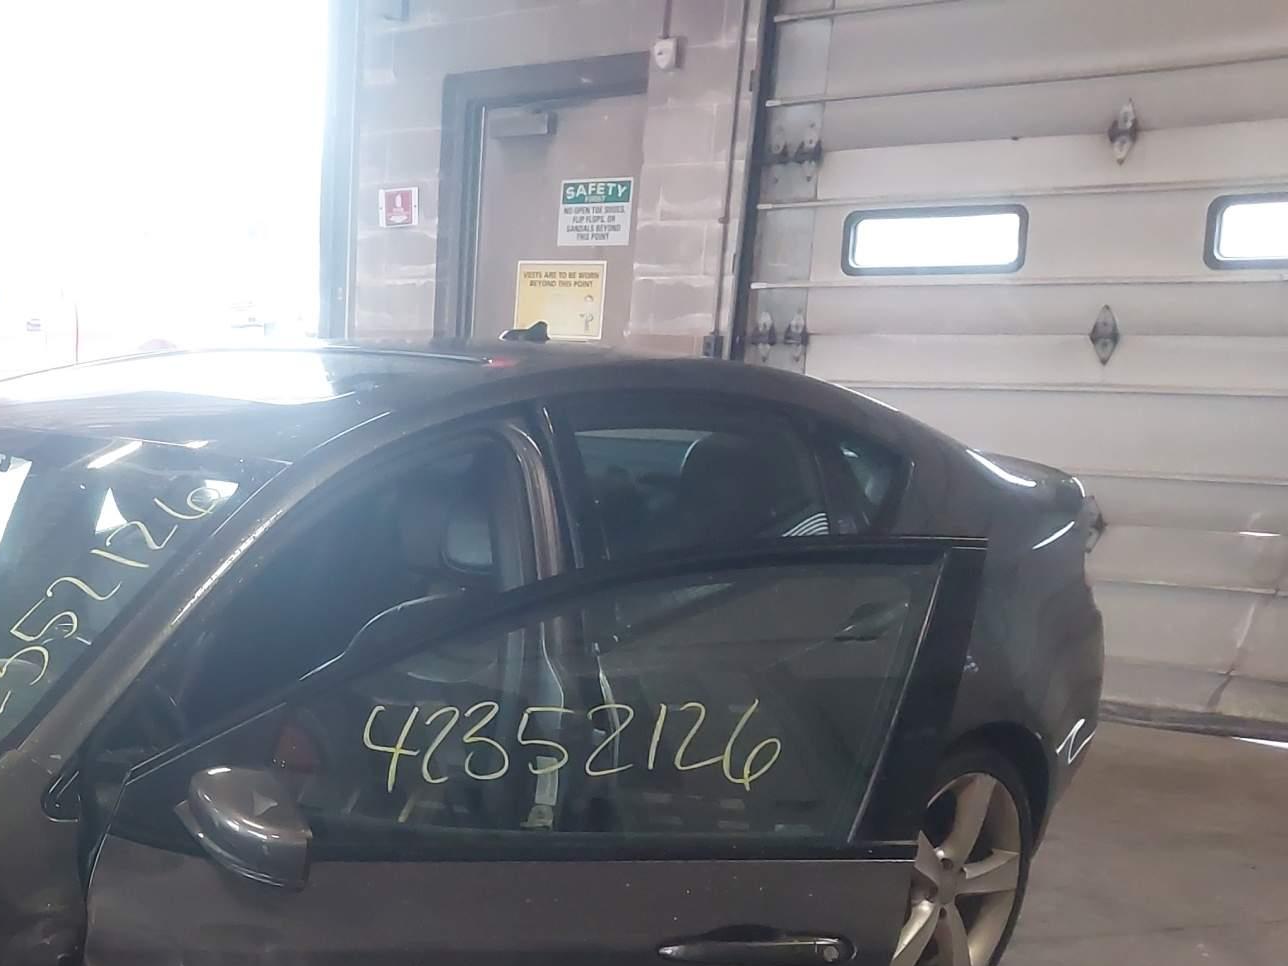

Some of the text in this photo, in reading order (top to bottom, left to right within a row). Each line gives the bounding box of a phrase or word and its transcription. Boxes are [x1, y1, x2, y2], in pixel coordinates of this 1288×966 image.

[566, 182, 627, 199] SAFETY
[596, 224, 621, 232] BEYOND
[363, 698, 781, 791] 42352126
